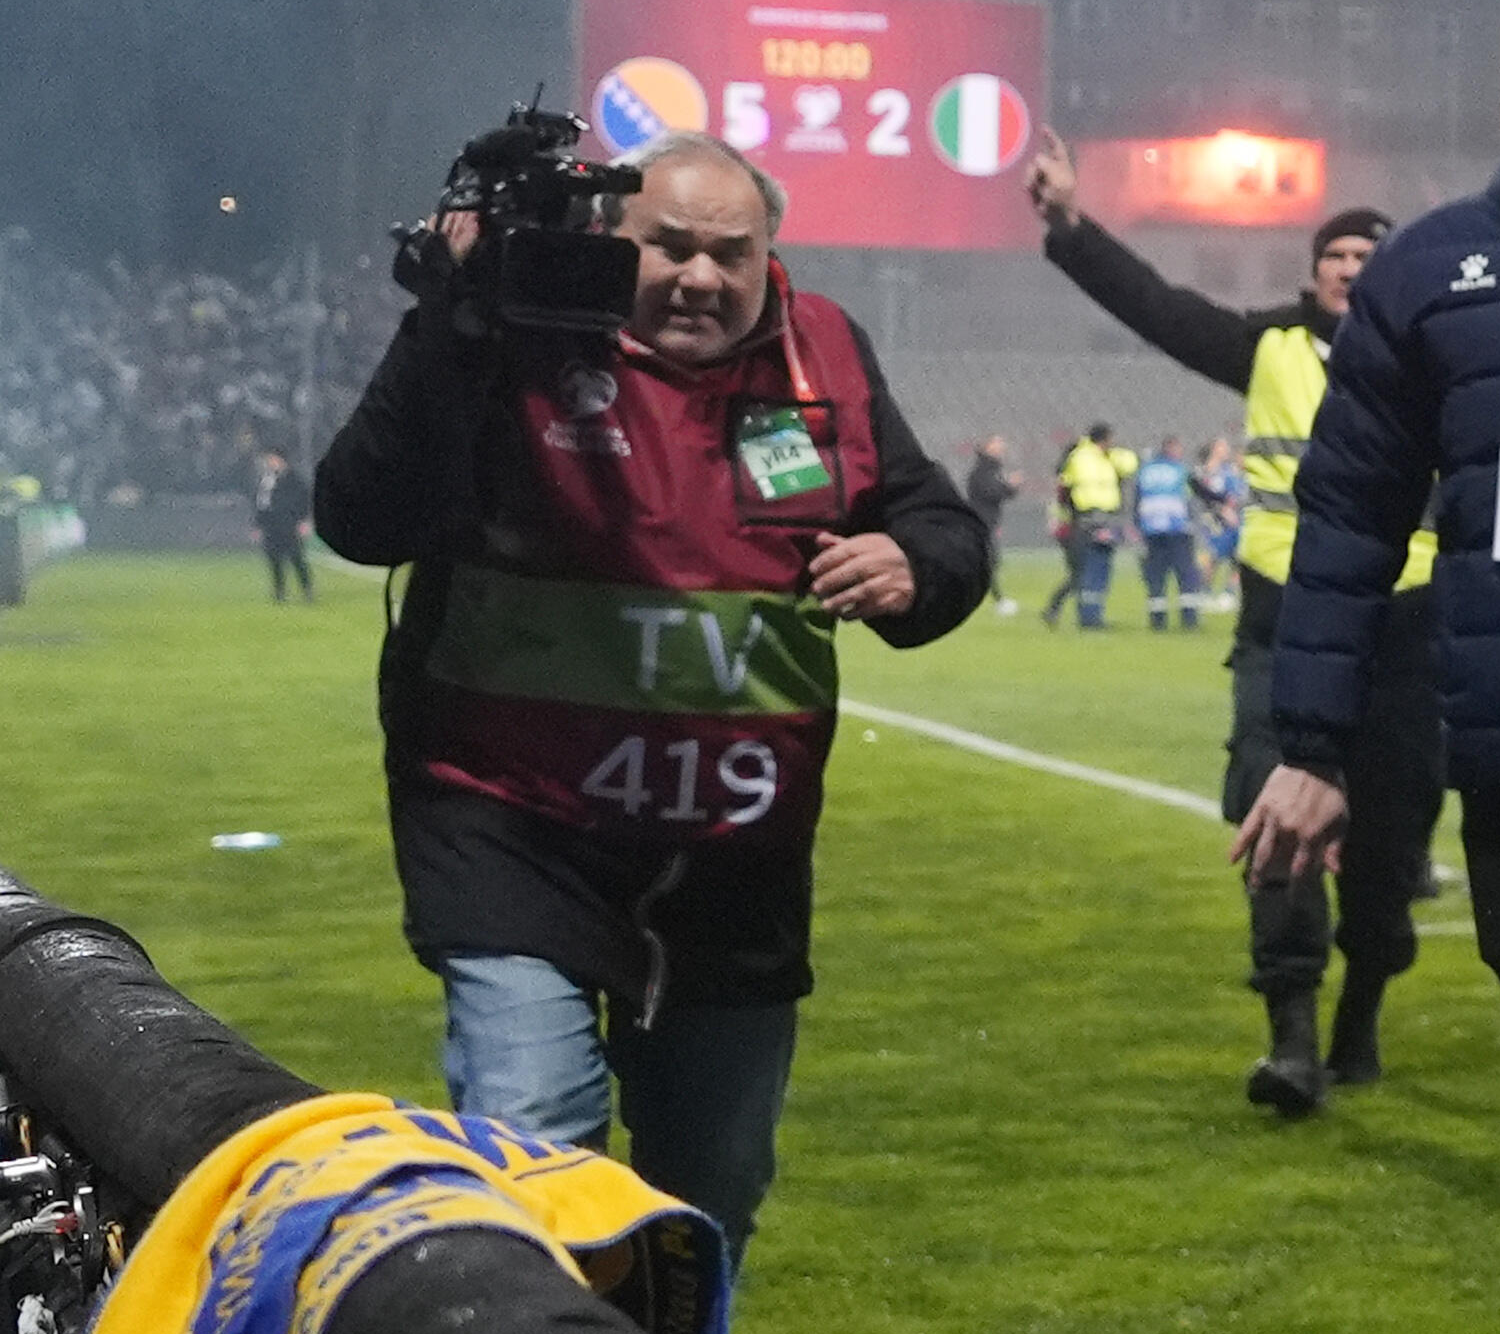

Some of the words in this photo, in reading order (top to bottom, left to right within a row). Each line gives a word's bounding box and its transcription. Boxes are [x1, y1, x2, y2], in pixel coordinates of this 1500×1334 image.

[722, 80, 771, 151] 5
[866, 87, 912, 158] 2
[619, 606, 764, 693] TV
[581, 735, 779, 825] 419
